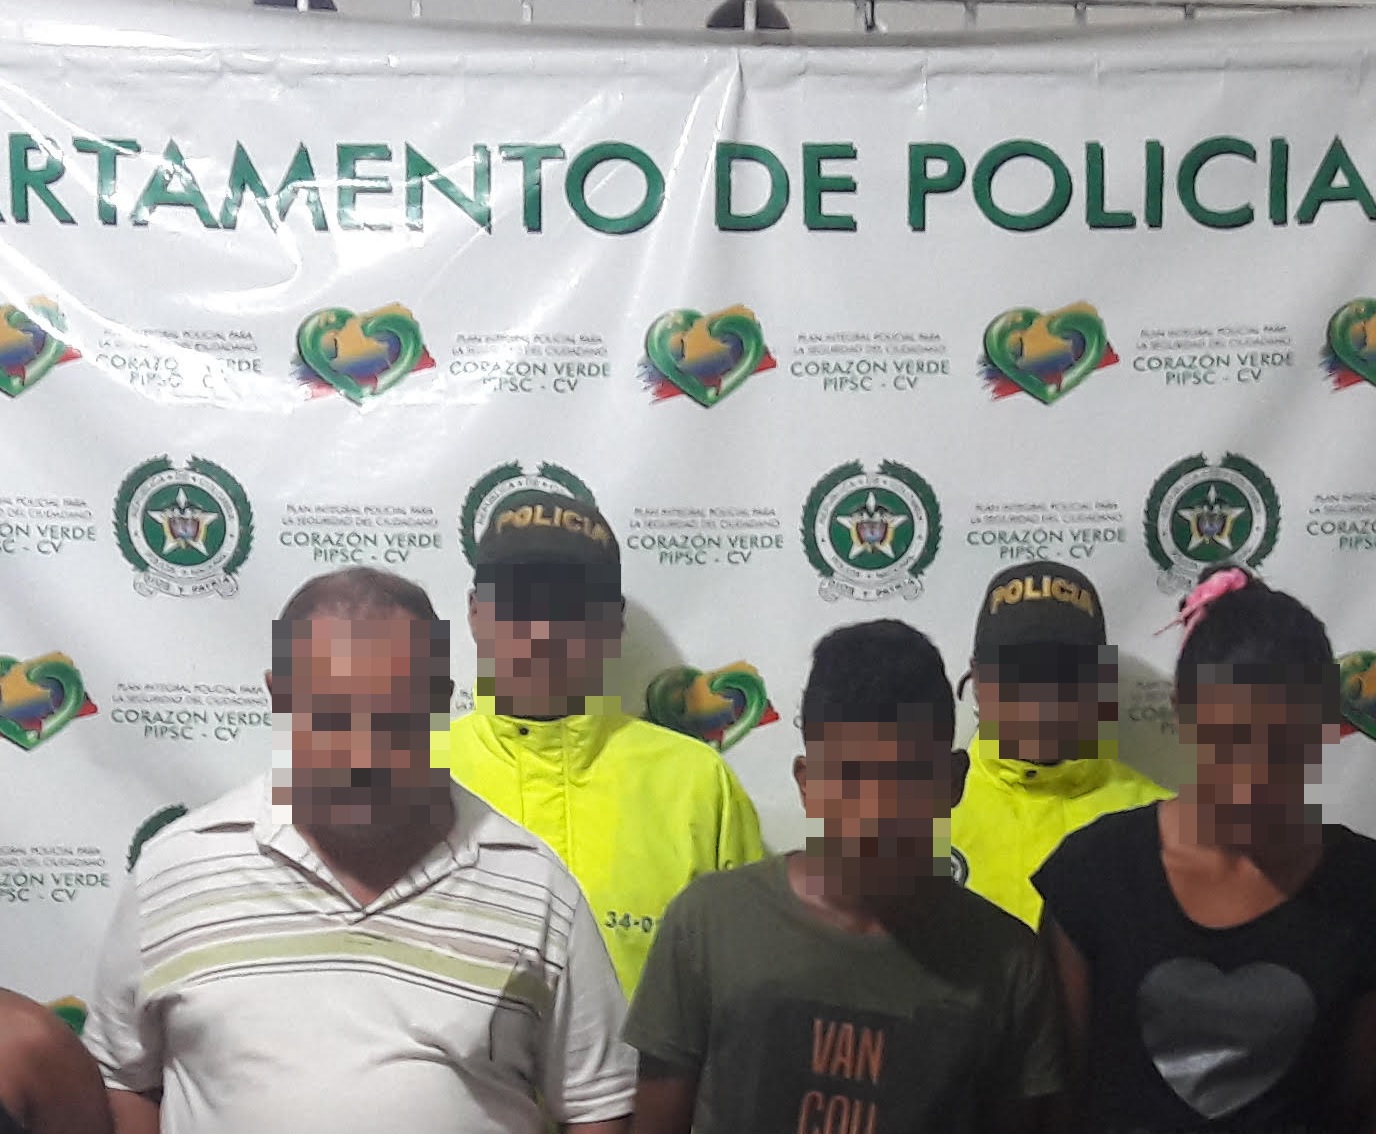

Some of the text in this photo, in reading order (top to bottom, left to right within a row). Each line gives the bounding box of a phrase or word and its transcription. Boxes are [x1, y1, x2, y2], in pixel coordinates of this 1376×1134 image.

[714, 141, 858, 232] DE
[1237, 351, 1294, 367] VERDE
[554, 362, 610, 376] VERDE
[894, 360, 949, 375] VERDE
[894, 376, 918, 390] CV
[1237, 369, 1261, 382] CV
[554, 378, 578, 393] CV
[497, 504, 612, 545] POLICIA
[37, 525, 96, 541] VERDE
[384, 533, 442, 548] VERDE
[1071, 529, 1126, 543] VERDE
[37, 540, 62, 554] CV
[728, 534, 783, 549] VERDE
[385, 548, 408, 563] CV
[727, 551, 751, 564] CV
[1070, 545, 1094, 559] CV
[990, 574, 1095, 616] POLICIA
[214, 712, 272, 726] VERDE
[144, 726, 193, 739] PIPSC
[215, 727, 239, 741] CV
[52, 873, 110, 887] VERDE
[52, 889, 75, 902] CV
[604, 910, 657, 934] 34-0
[811, 1017, 888, 1084] VAN
